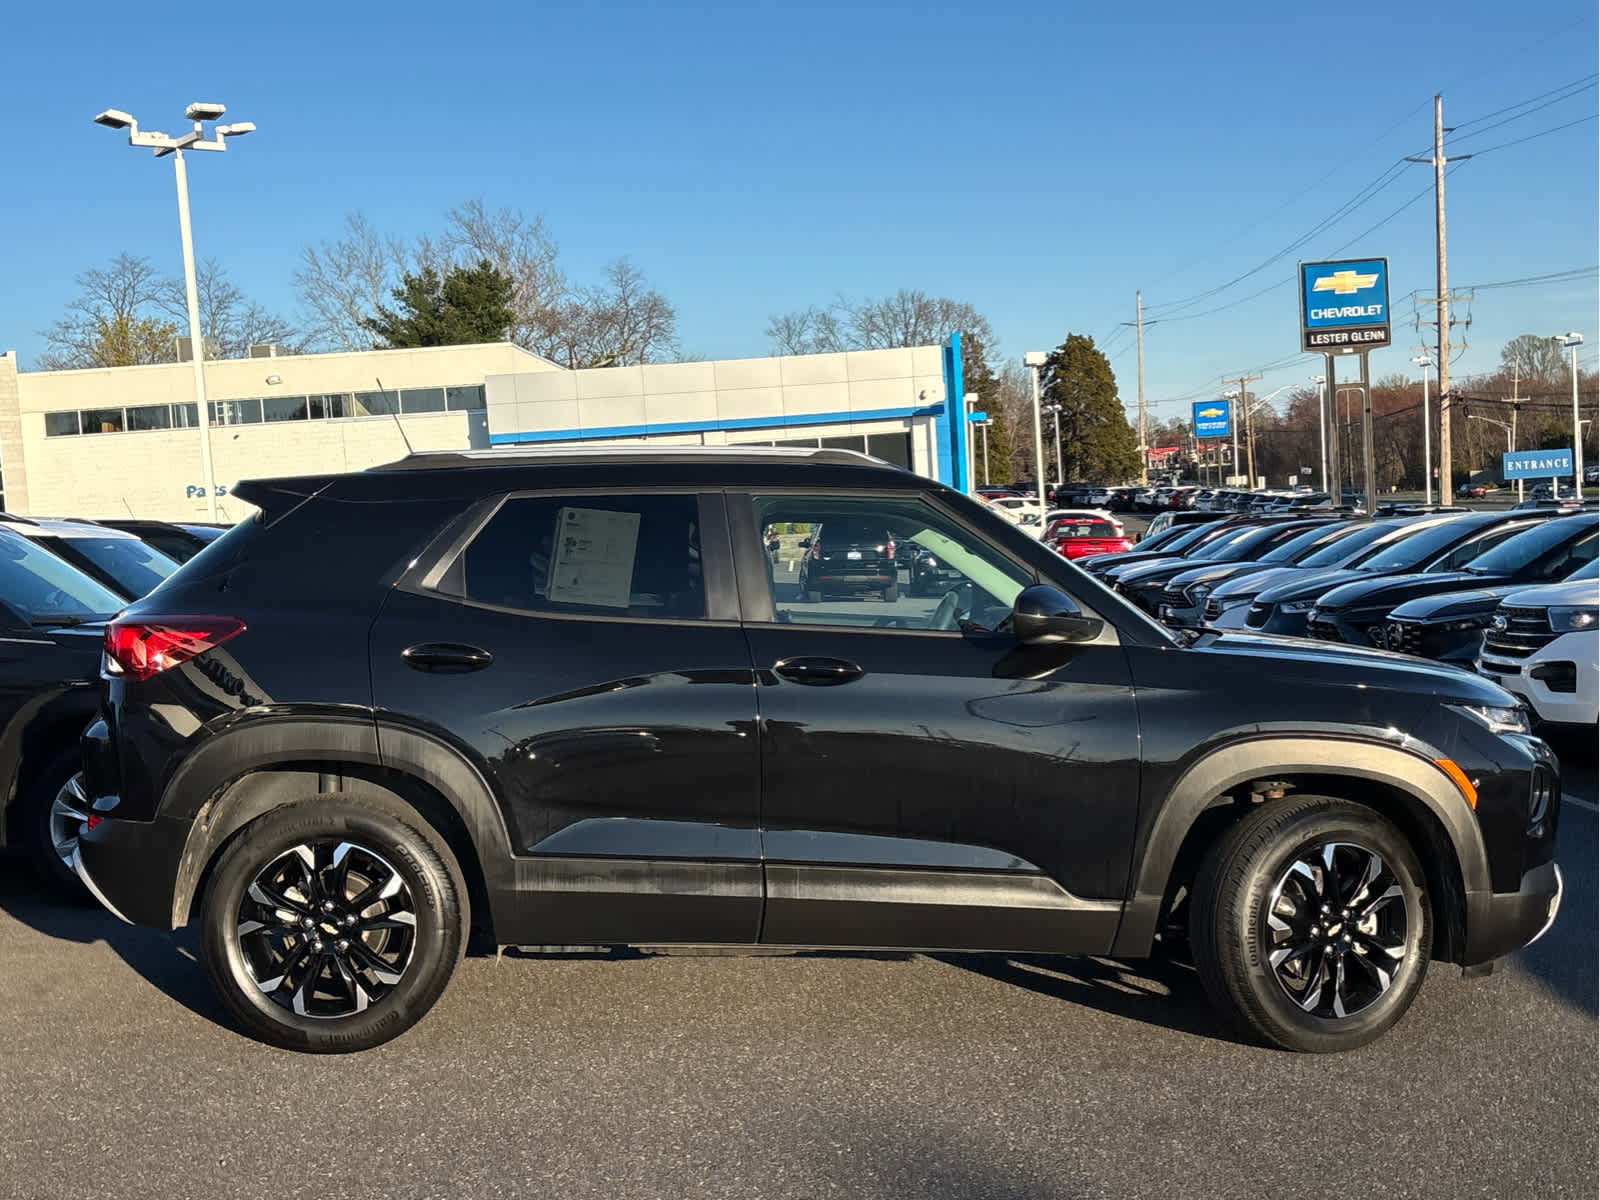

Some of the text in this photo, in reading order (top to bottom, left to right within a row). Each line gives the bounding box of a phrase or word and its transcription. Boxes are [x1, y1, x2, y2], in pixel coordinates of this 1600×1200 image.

[1311, 304, 1383, 319] CHEVROLET
[1311, 330, 1385, 344] LESTER GLENN
[1507, 457, 1569, 471] ENTRANCE
[186, 485, 227, 499] Pats
